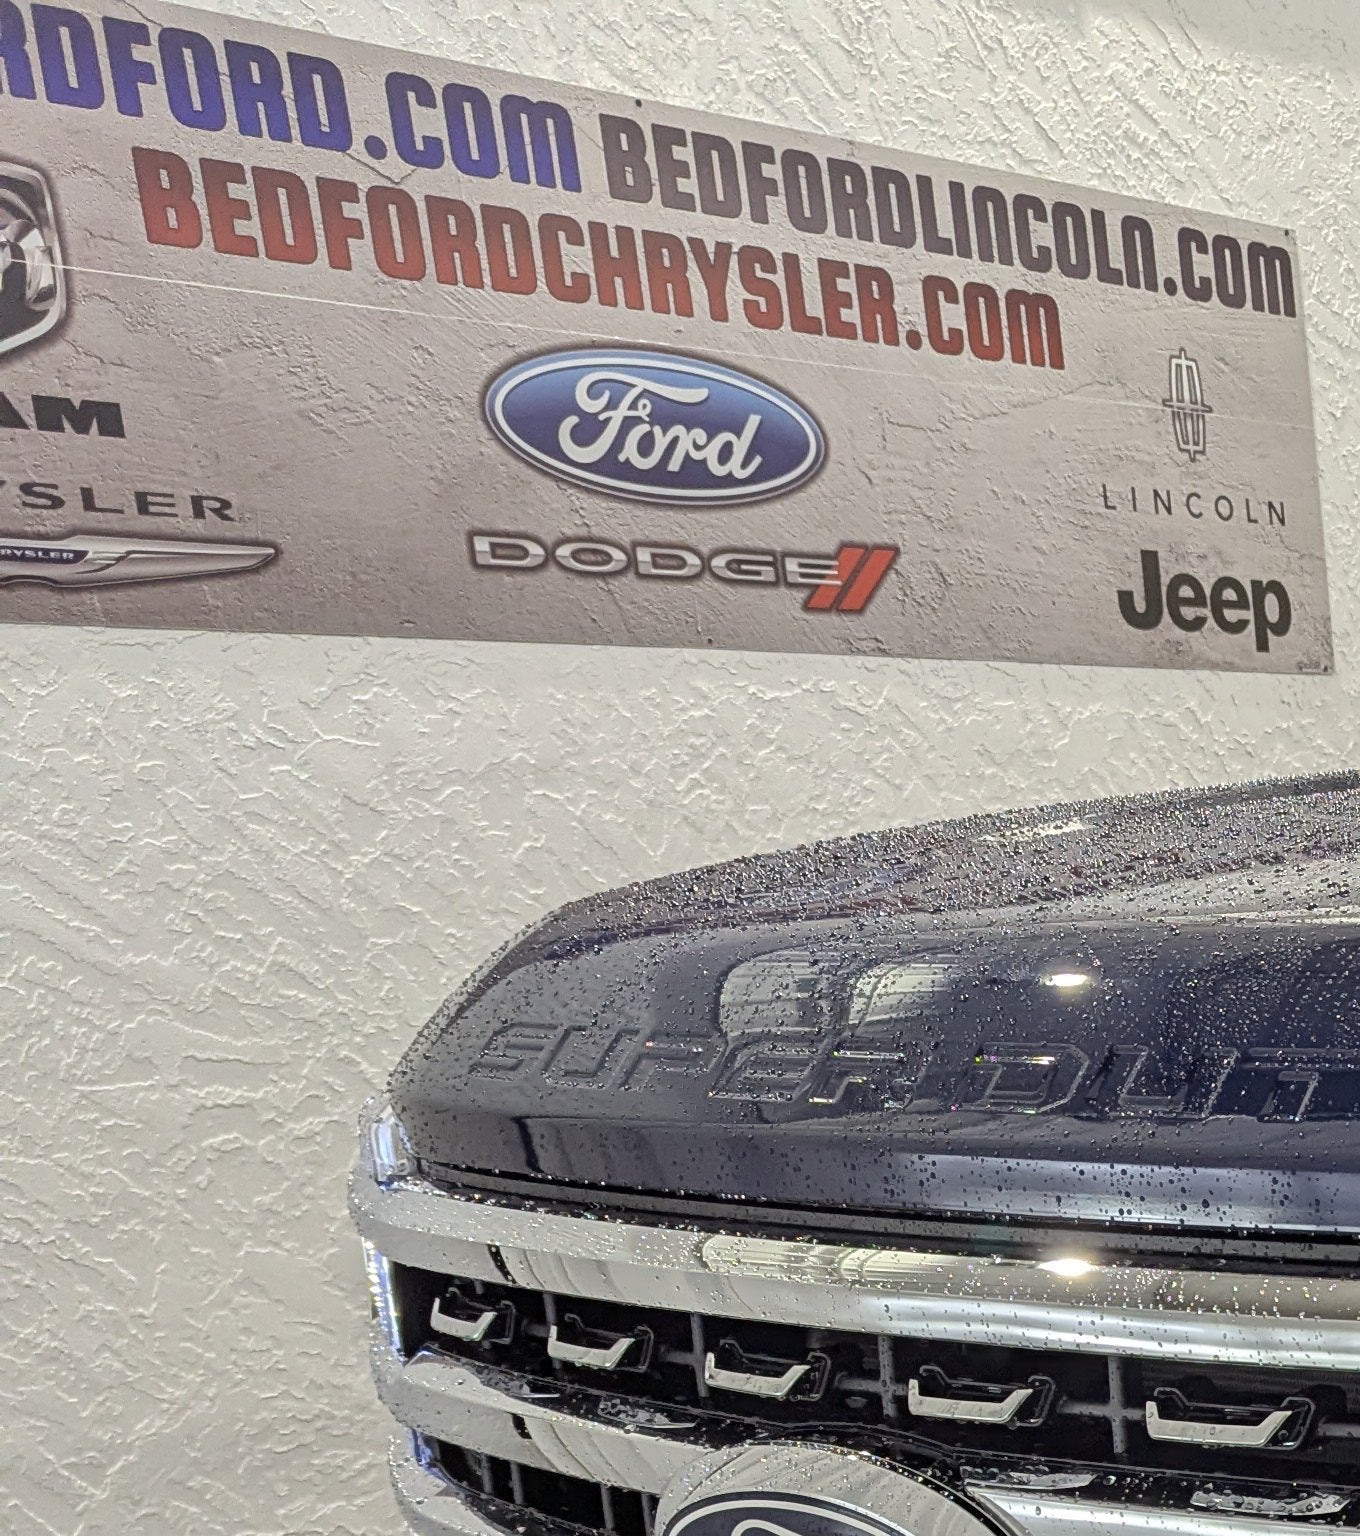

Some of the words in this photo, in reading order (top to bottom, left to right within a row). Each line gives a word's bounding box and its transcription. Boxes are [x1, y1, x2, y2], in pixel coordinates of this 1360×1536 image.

[131, 146, 1066, 371] BEDFORDCHRYSLER.COM
[599, 112, 1297, 319] BEDFORDLINCOLN.COM
[557, 370, 763, 480] Ford
[0, 480, 236, 522] SLER
[1102, 483, 1287, 527] LINCOLN
[472, 535, 844, 587] DODGE
[1116, 548, 1293, 653] Jeep
[468, 1020, 930, 1109] SUPER
